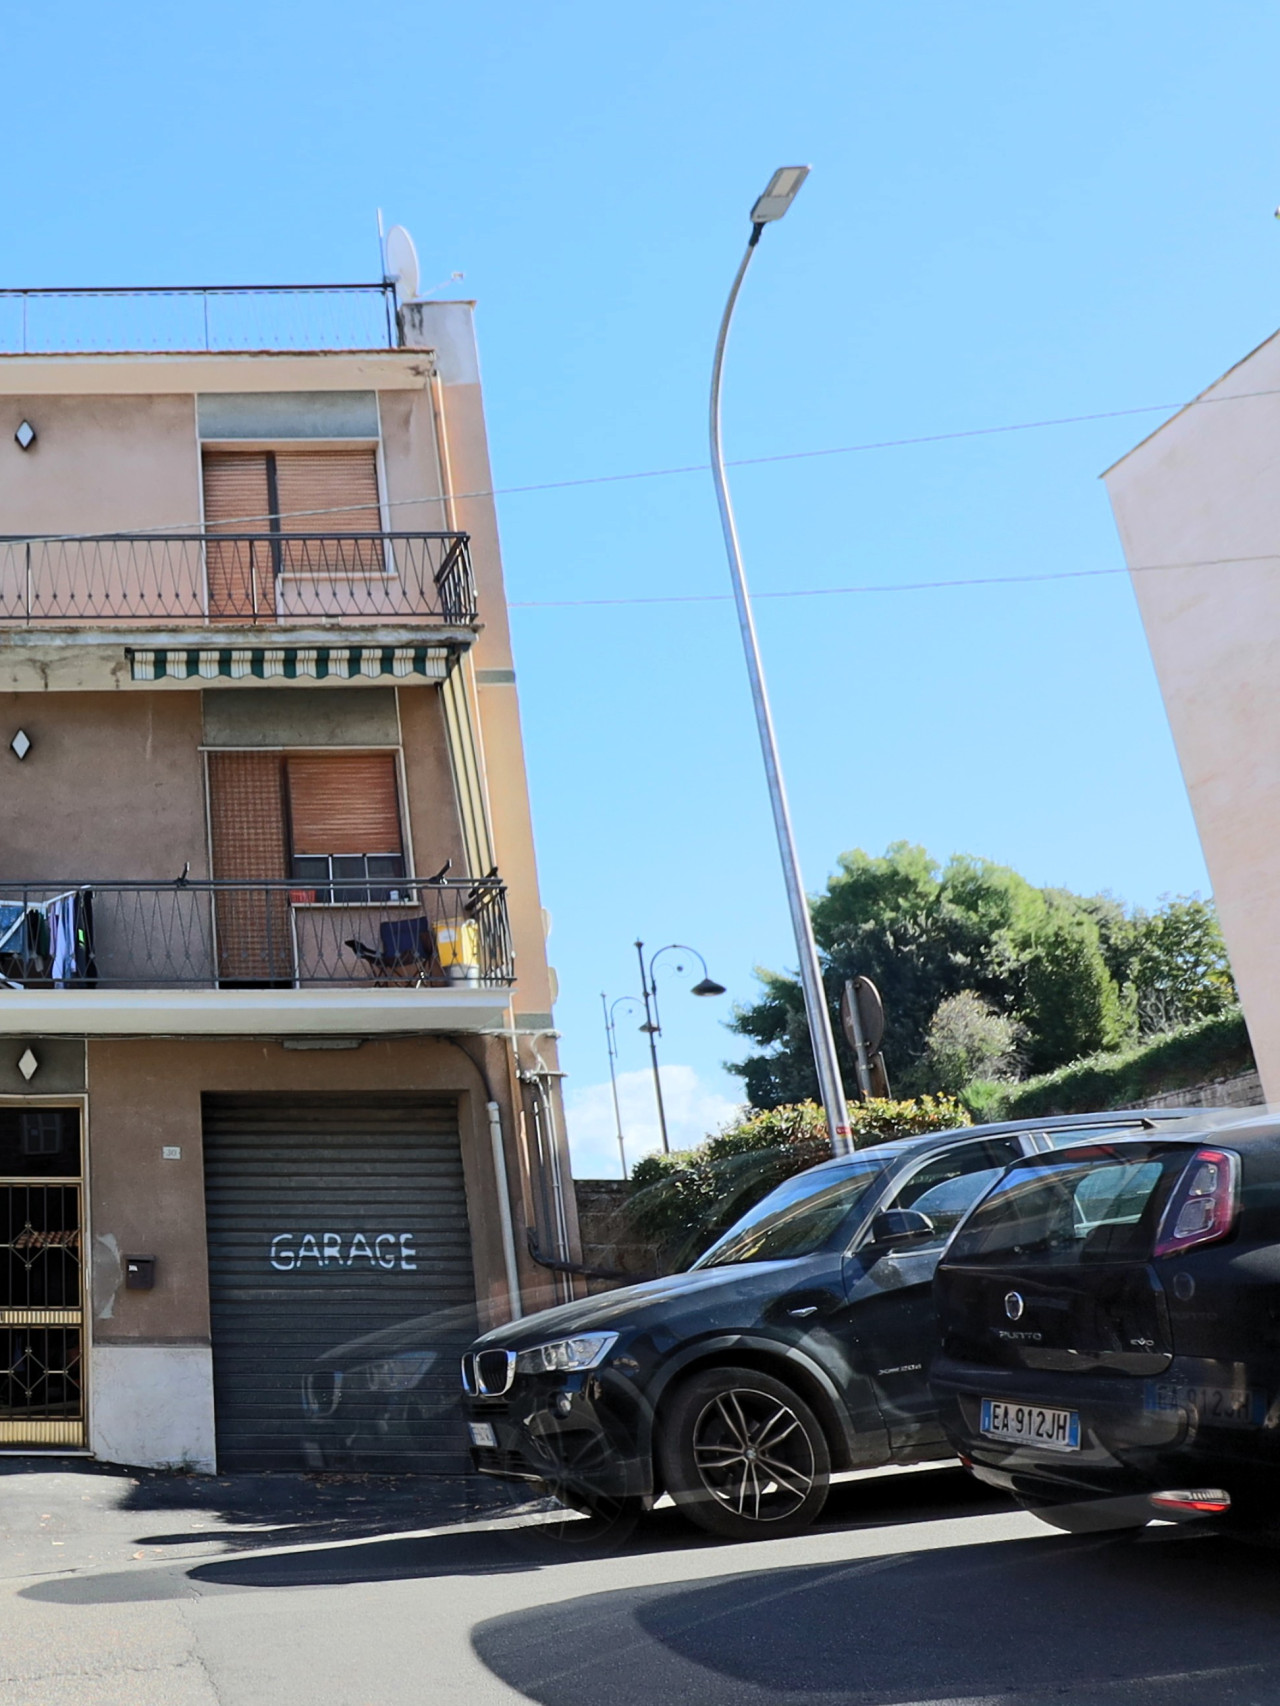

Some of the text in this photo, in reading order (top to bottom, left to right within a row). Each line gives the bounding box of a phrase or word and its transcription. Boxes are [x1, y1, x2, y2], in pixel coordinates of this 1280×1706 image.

[270, 1232, 418, 1271] GARAGE
[999, 1331, 1042, 1341] PUNTO
[993, 1404, 1068, 1441] EA 912JH
